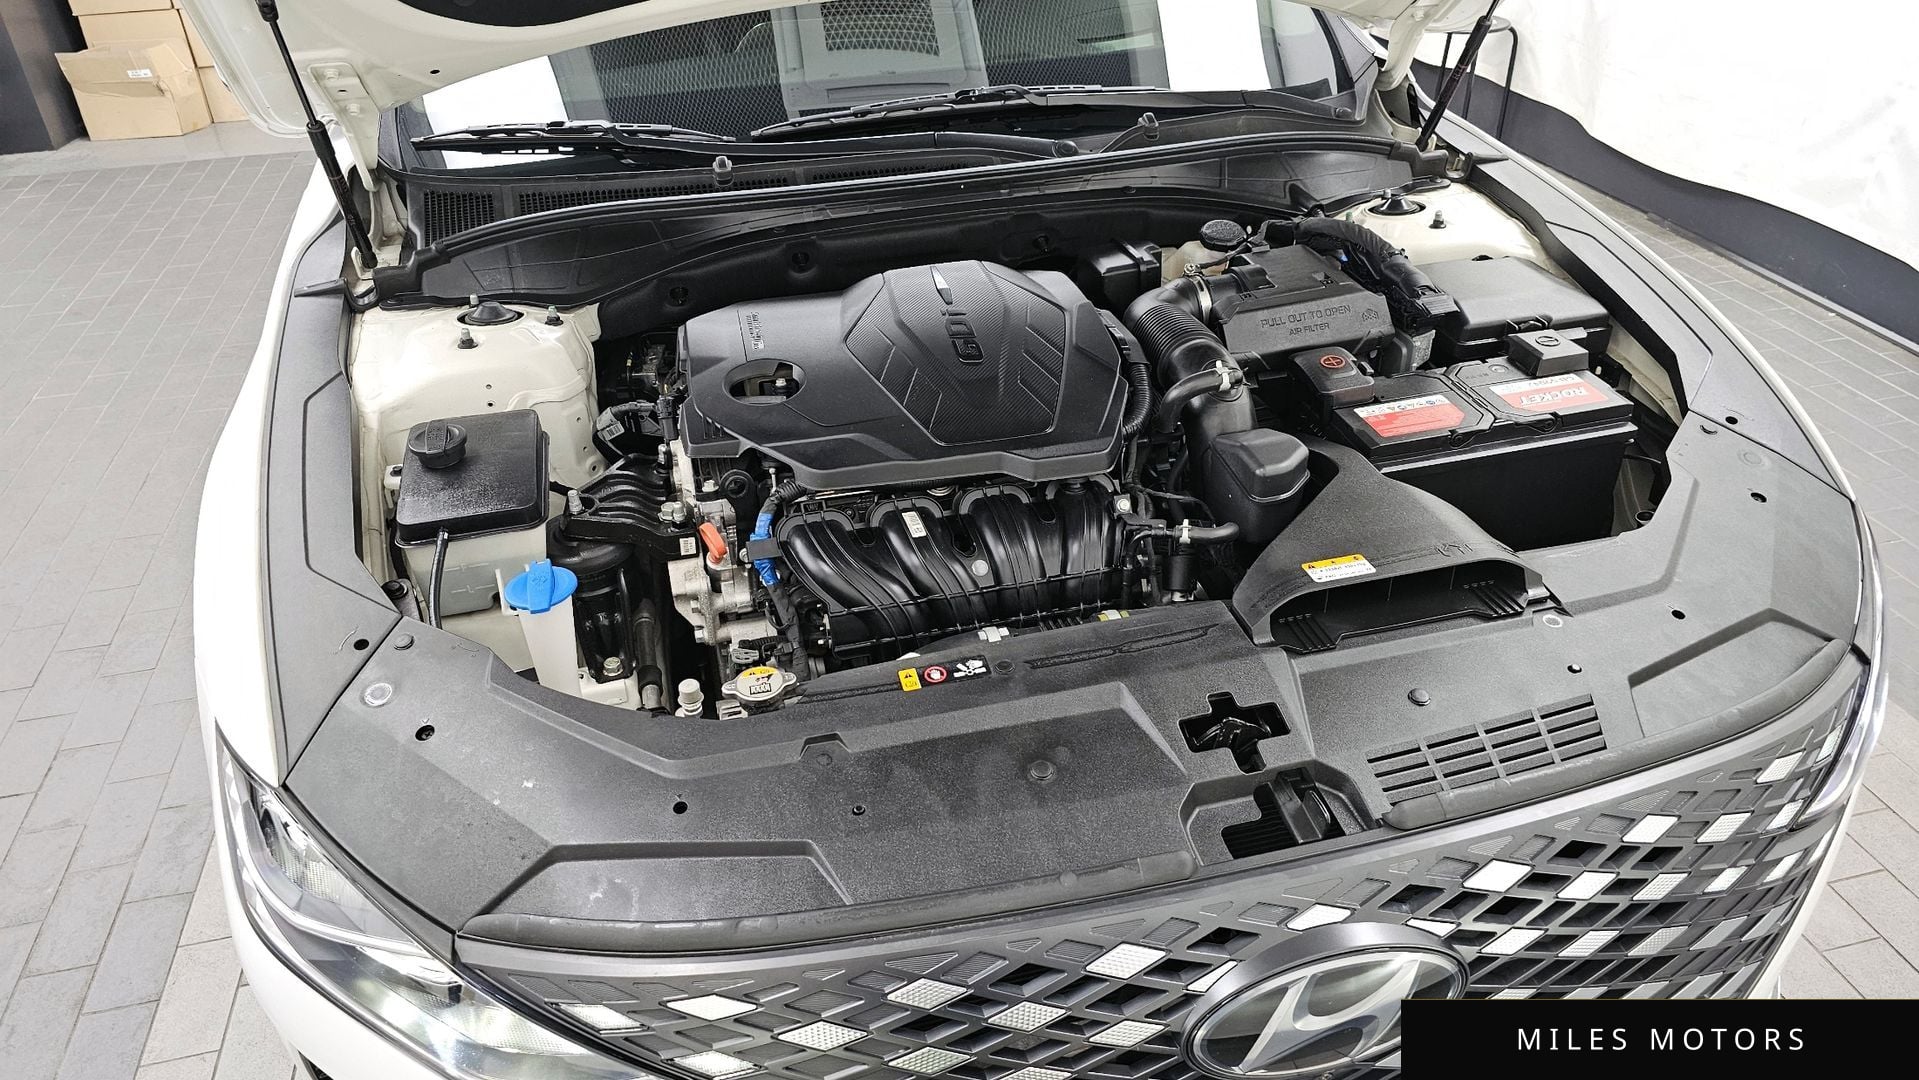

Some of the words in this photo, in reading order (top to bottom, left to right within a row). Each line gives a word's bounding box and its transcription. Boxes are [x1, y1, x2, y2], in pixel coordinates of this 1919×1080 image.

[1260, 317, 1287, 329] PULL
[1288, 312, 1307, 323] OUT
[1309, 310, 1323, 319] TO
[1325, 305, 1351, 316] OPEN
[1289, 327, 1303, 336] AIR
[1304, 322, 1330, 333] FILTER
[1520, 386, 1588, 405] ROCKET
